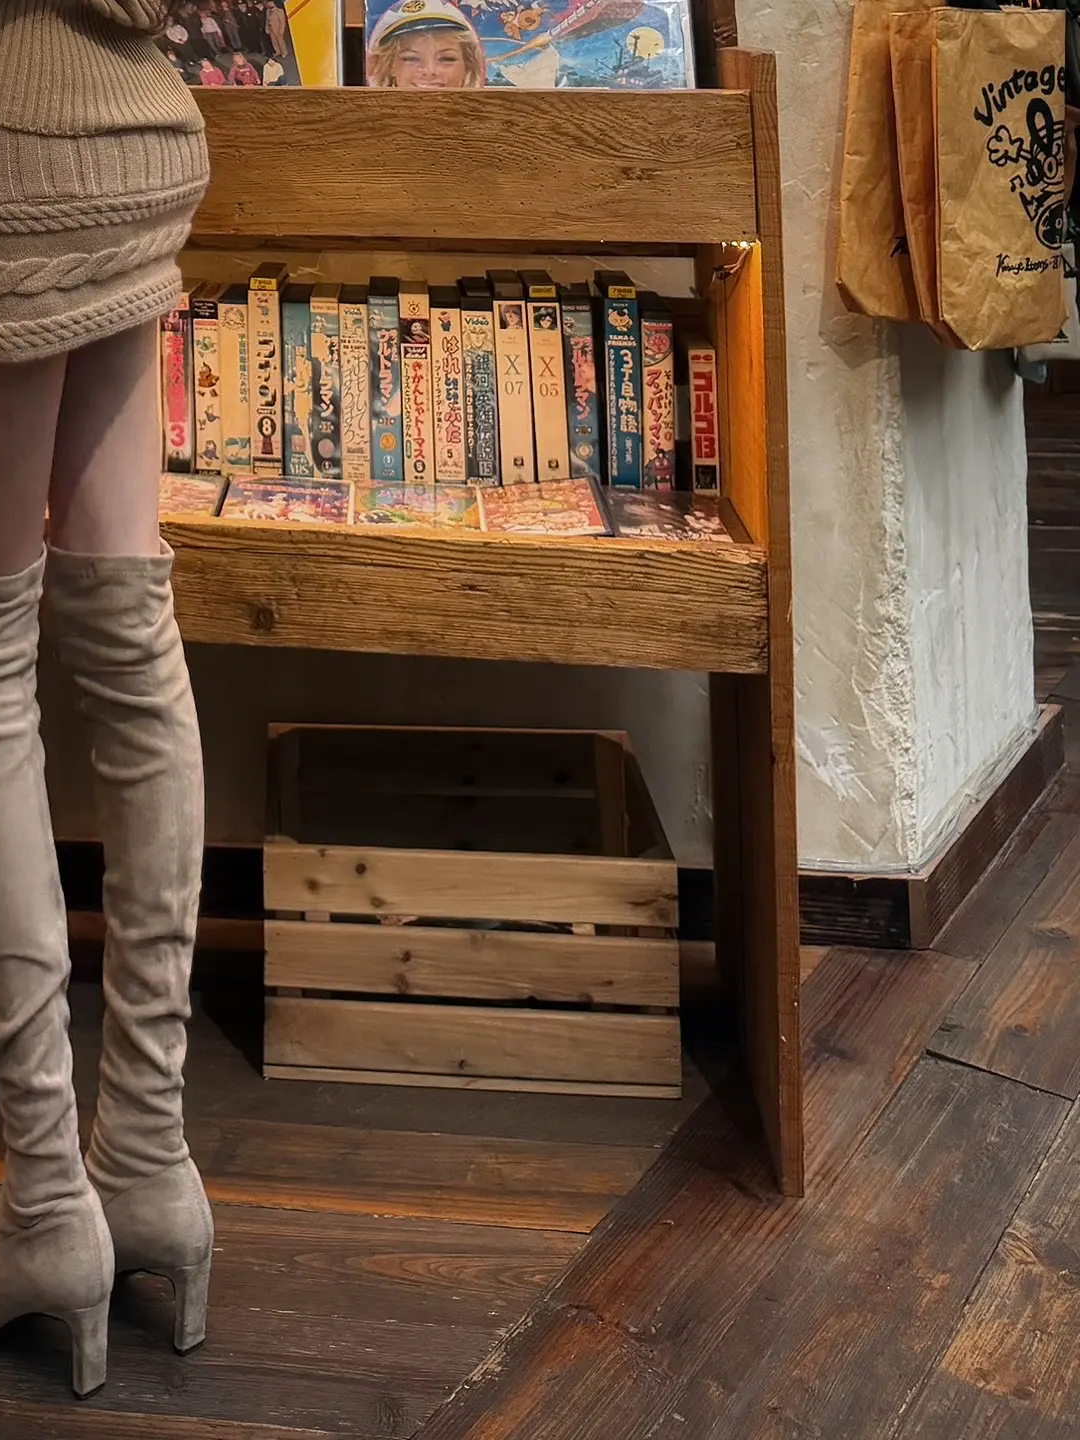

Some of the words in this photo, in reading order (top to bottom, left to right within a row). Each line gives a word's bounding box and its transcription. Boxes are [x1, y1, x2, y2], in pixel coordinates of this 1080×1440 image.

[975, 64, 1068, 128] Vintage
[464, 317, 490, 326] Video
[503, 355, 521, 376] X
[538, 356, 557, 377] X
[504, 380, 523, 396] 07
[539, 382, 559, 397] 05
[619, 348, 638, 433] 3丁目物語
[411, 361, 425, 459] きかんしゃトーマス
[474, 353, 495, 461] 銀河英雄伝説
[646, 369, 664, 453] アンパンマン
[692, 371, 717, 459] ゴルゴ13
[170, 423, 186, 448] 3
[446, 449, 453, 459] 5
[480, 463, 493, 475] 15
